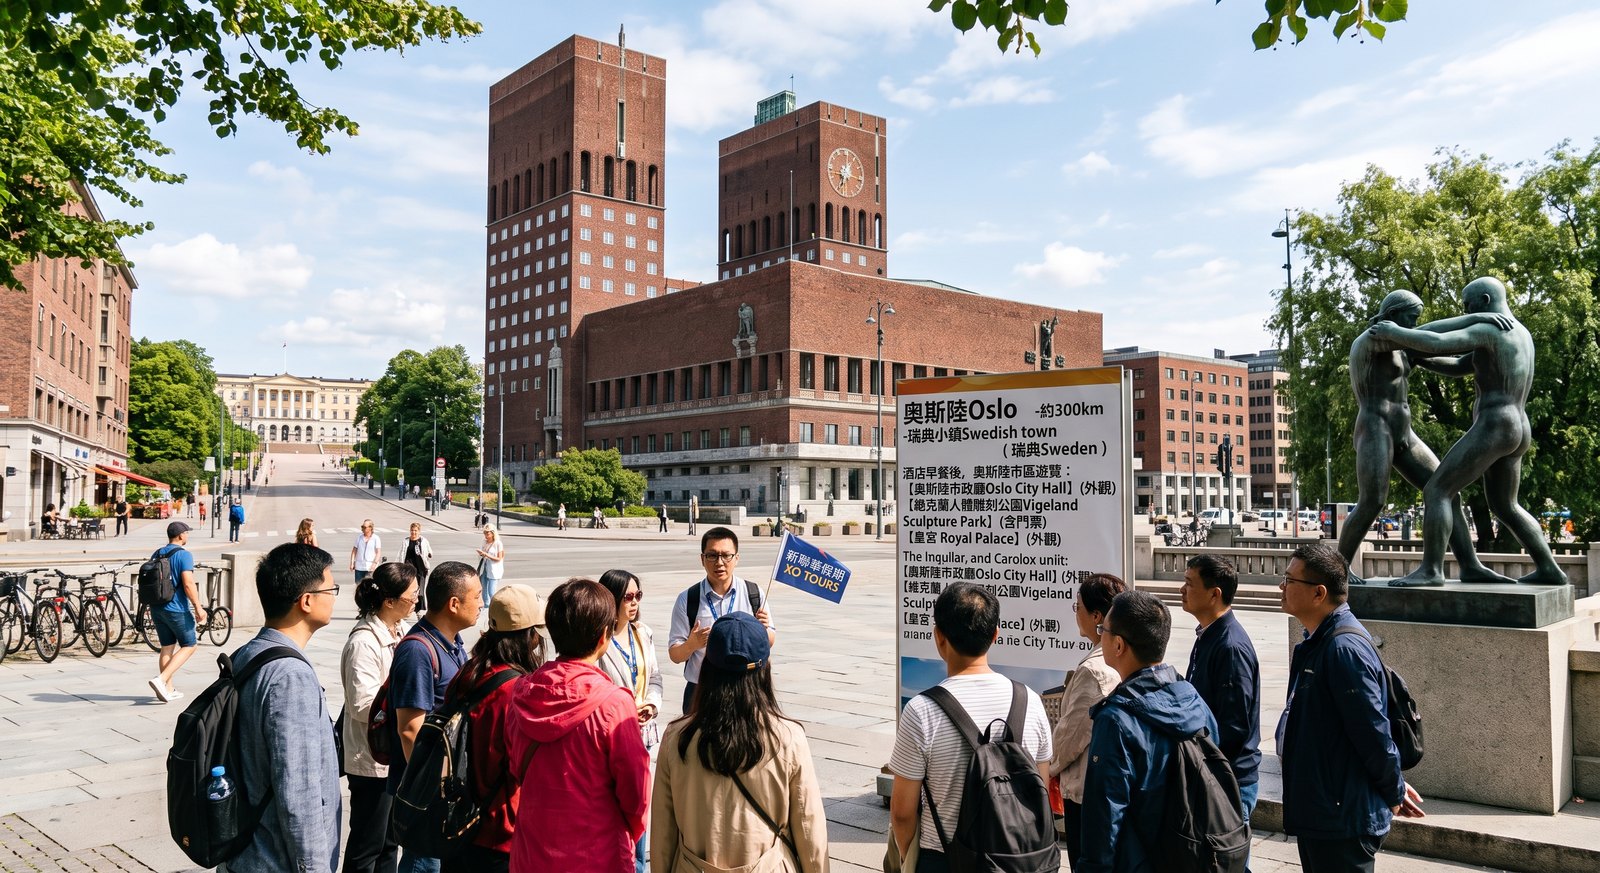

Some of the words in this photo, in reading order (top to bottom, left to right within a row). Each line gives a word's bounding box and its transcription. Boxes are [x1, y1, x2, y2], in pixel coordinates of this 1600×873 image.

[1035, 402, 1103, 418] -約300km
[903, 425, 1017, 443] -瑞典小鎮Swedish
[1021, 426, 1056, 438] town
[910, 482, 1012, 496] 【奧斯陸市政廳Oslo
[1016, 482, 1038, 497] City
[1080, 481, 1116, 496] (外觀)
[904, 515, 957, 529] Sculpture
[961, 515, 991, 528] Park】
[1000, 515, 1046, 529] (含門票)
[910, 531, 937, 544] 【皇宮
[941, 532, 972, 546] Royal
[976, 532, 1018, 546] Palace】
[1027, 532, 1061, 547] (外觀)
[903, 551, 922, 562] The
[971, 552, 991, 563] and
[994, 553, 1036, 565] Carolox
[1040, 554, 1068, 566] uniit:
[784, 564, 801, 577] XO
[805, 571, 839, 592] TOURS
[1004, 569, 1026, 582] City
[1030, 570, 1056, 583] Hall】
[1062, 570, 1096, 584] (外觀
[998, 618, 1024, 631] lace】
[1030, 619, 1060, 634] (外觀)
[1024, 636, 1045, 650] City
